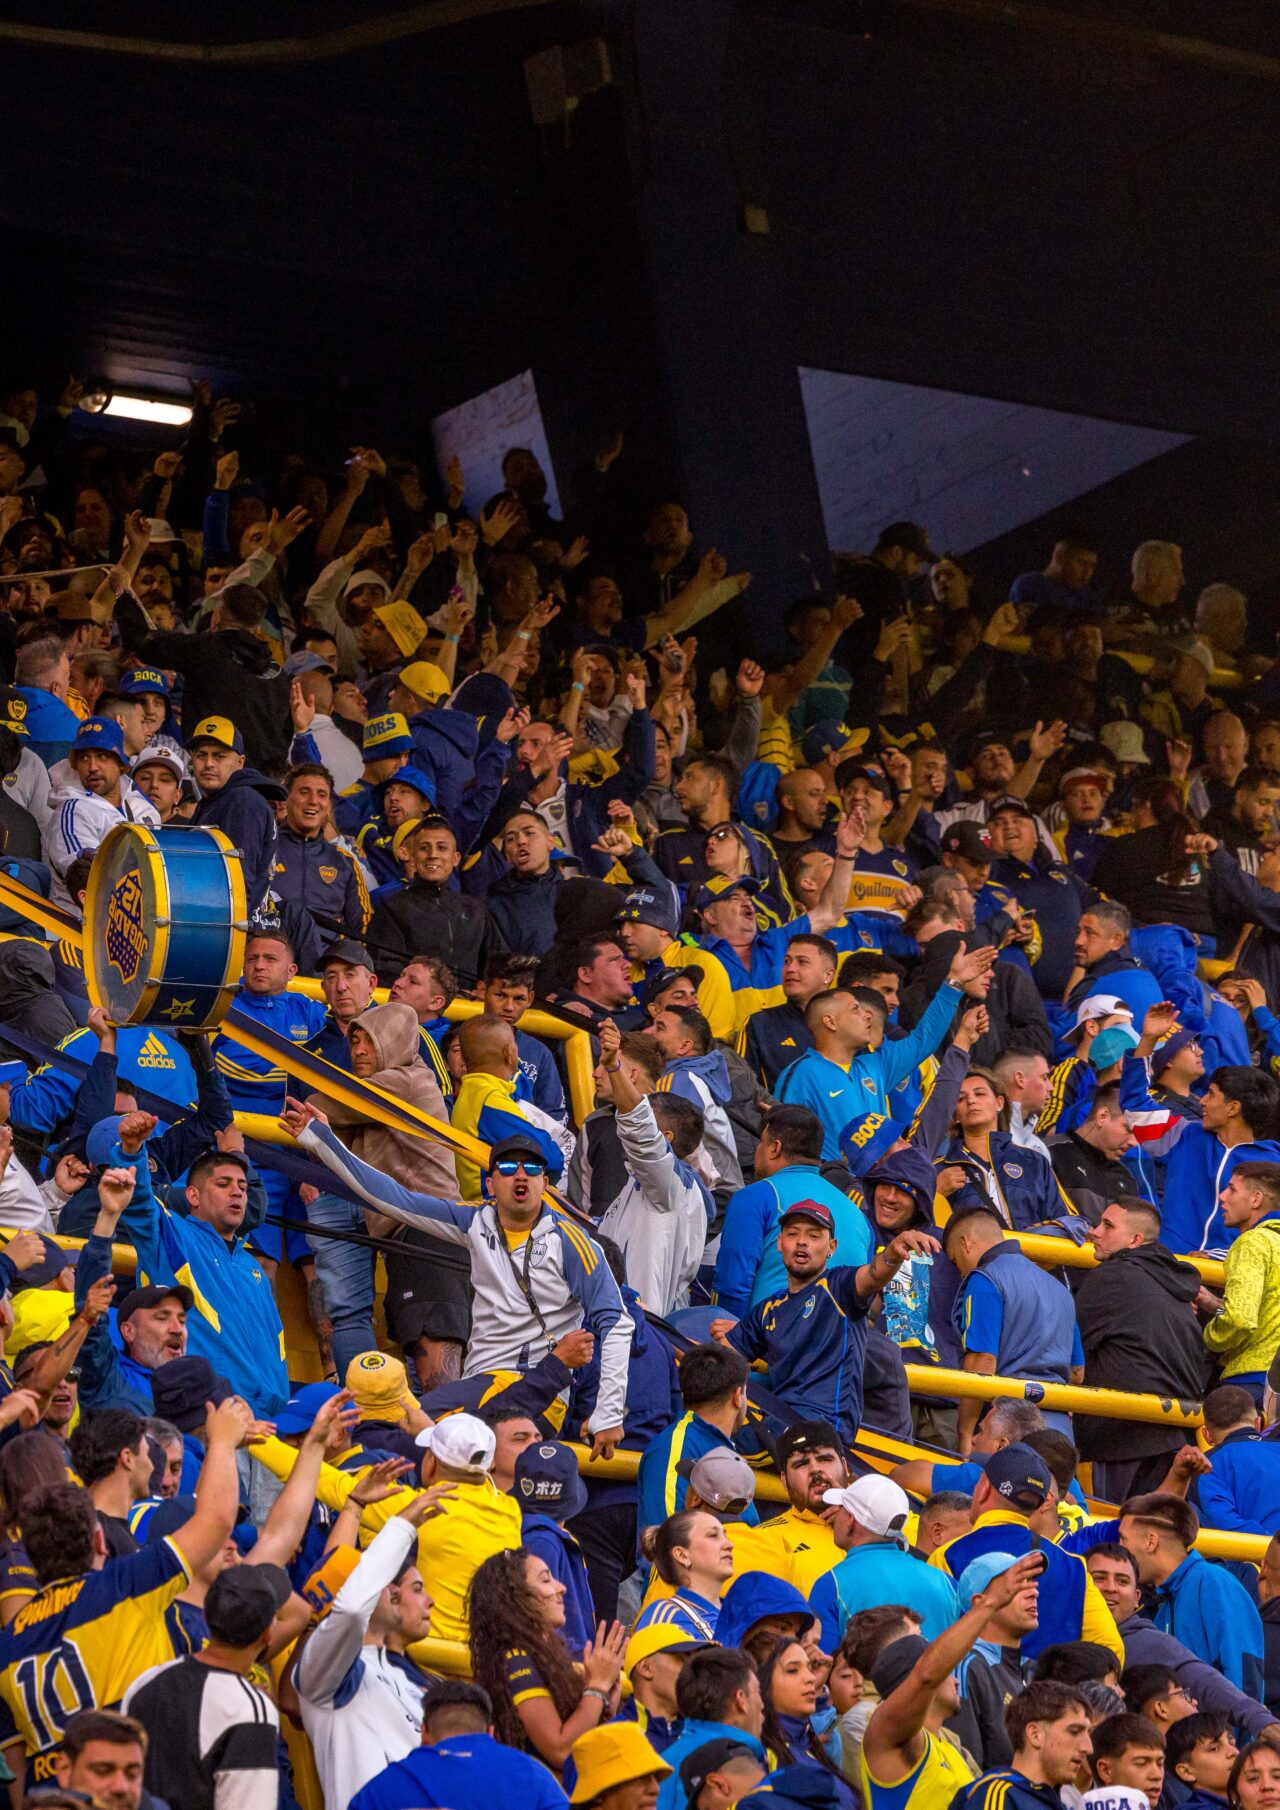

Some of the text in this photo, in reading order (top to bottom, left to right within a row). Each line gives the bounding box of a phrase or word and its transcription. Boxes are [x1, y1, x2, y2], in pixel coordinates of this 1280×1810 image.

[133, 671, 163, 687] BOCA
[122, 880, 141, 917] 12
[137, 1055, 176, 1070] adidas
[850, 1112, 886, 1149] BOCA
[14, 1636, 97, 1752] 10
